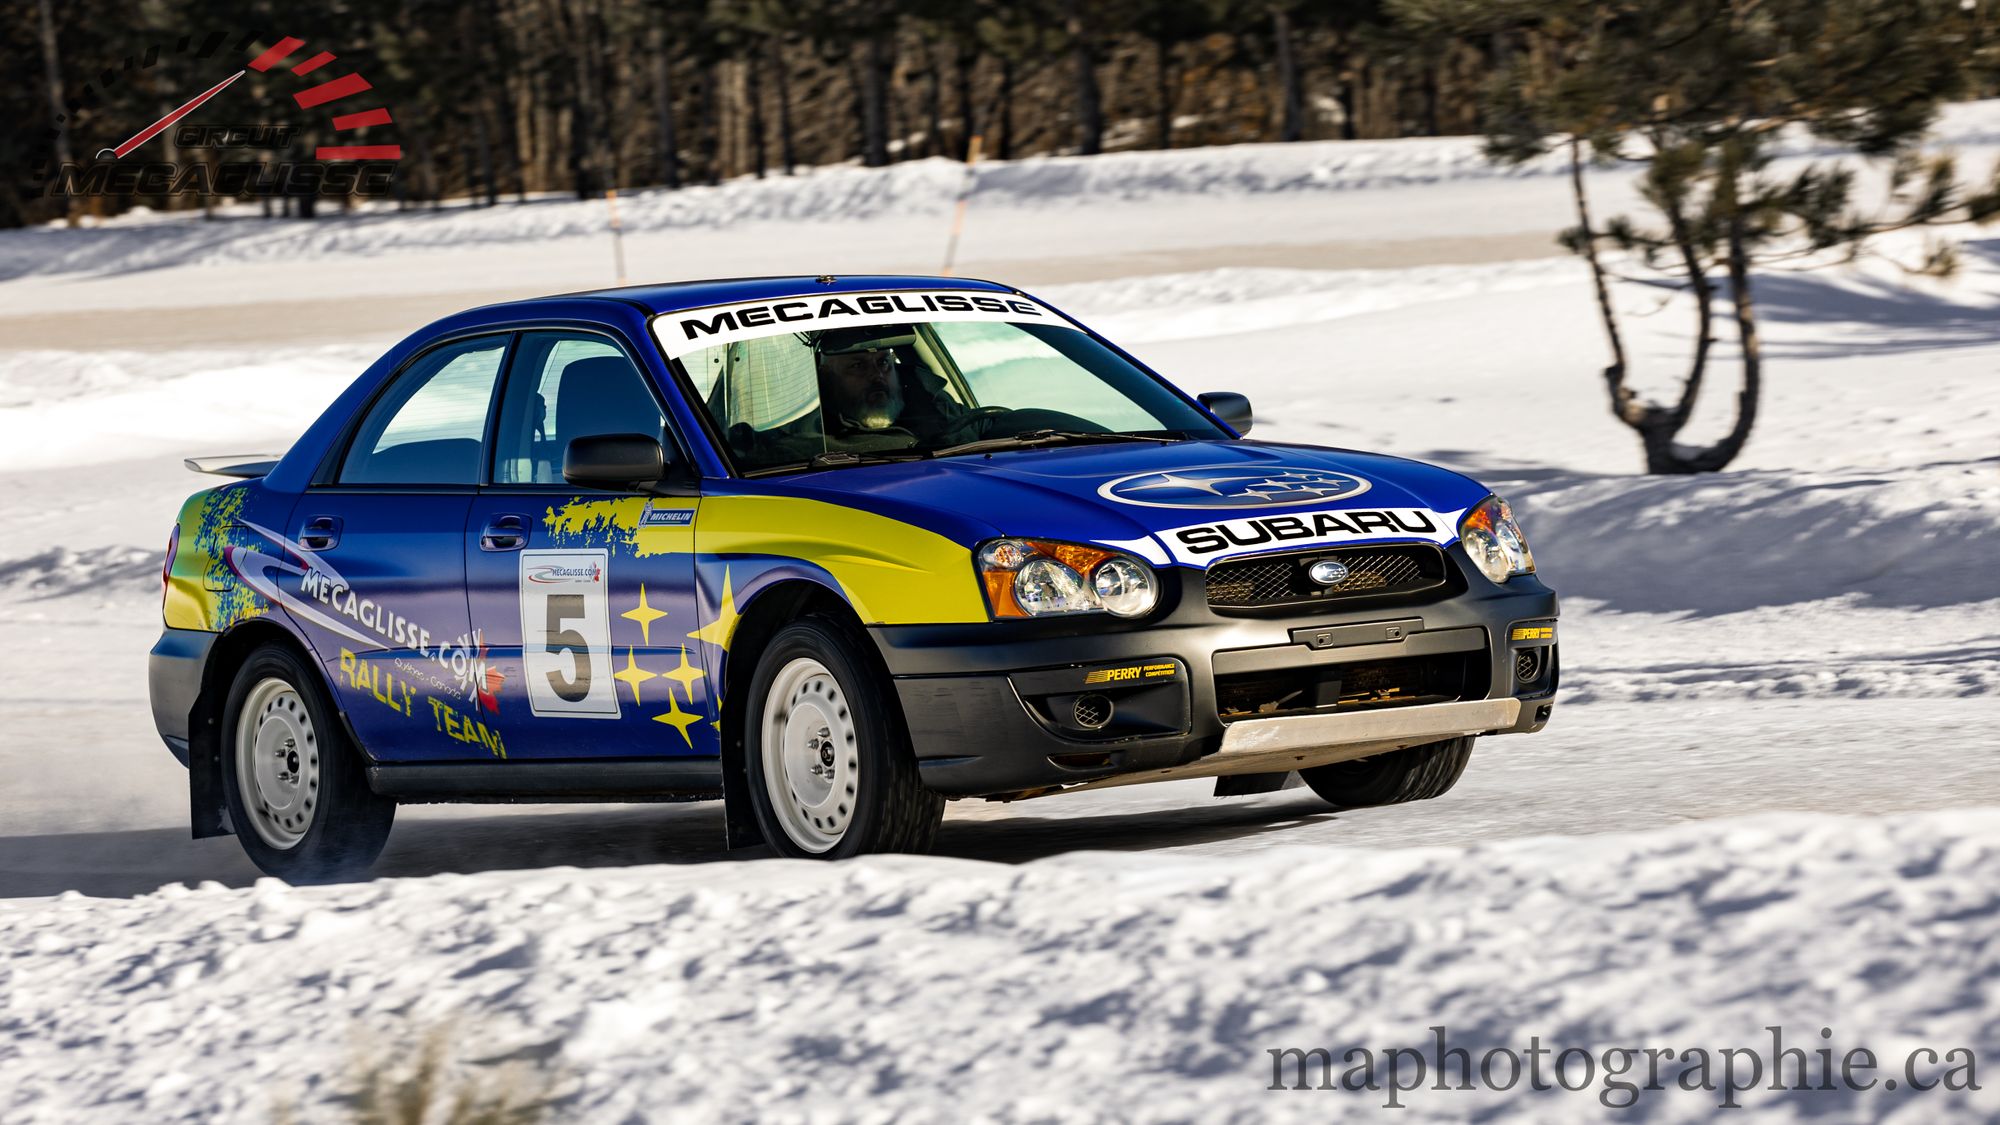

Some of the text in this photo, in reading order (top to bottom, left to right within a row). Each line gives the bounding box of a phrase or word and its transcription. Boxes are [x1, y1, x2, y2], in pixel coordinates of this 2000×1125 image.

[680, 295, 1041, 340] MECAGLISSE
[650, 512, 692, 521] MICHELIN
[1176, 510, 1437, 554] SUBARU
[301, 567, 489, 693] MECAGLISSE.COM
[546, 594, 592, 703] 5
[1106, 666, 1142, 681] PERRY
[339, 647, 507, 759] RALLY TEAM
